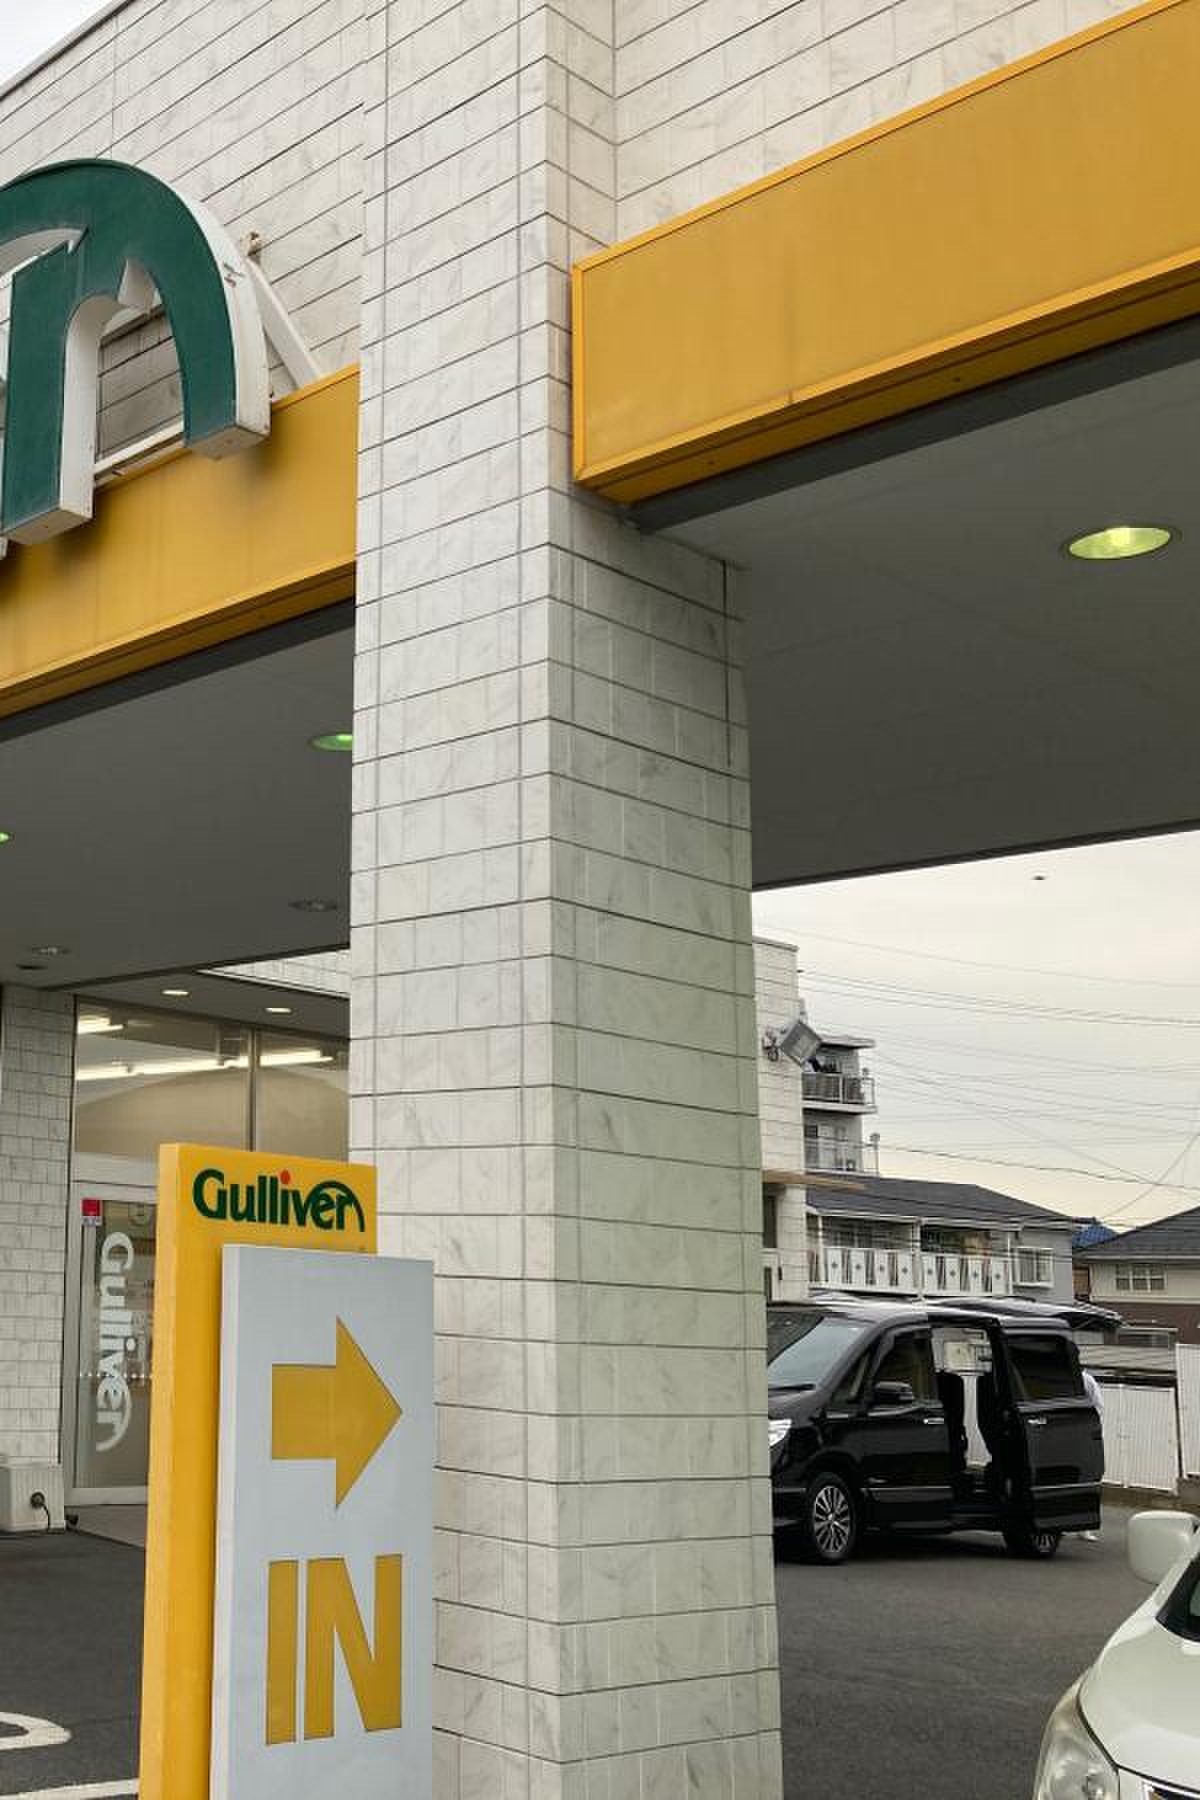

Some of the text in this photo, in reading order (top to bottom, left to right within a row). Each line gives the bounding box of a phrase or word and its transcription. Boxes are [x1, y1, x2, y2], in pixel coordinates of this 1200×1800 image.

[193, 1168, 365, 1232] Gulliver
[96, 1231, 134, 1452] Gulliver
[265, 1553, 403, 1746] IN
